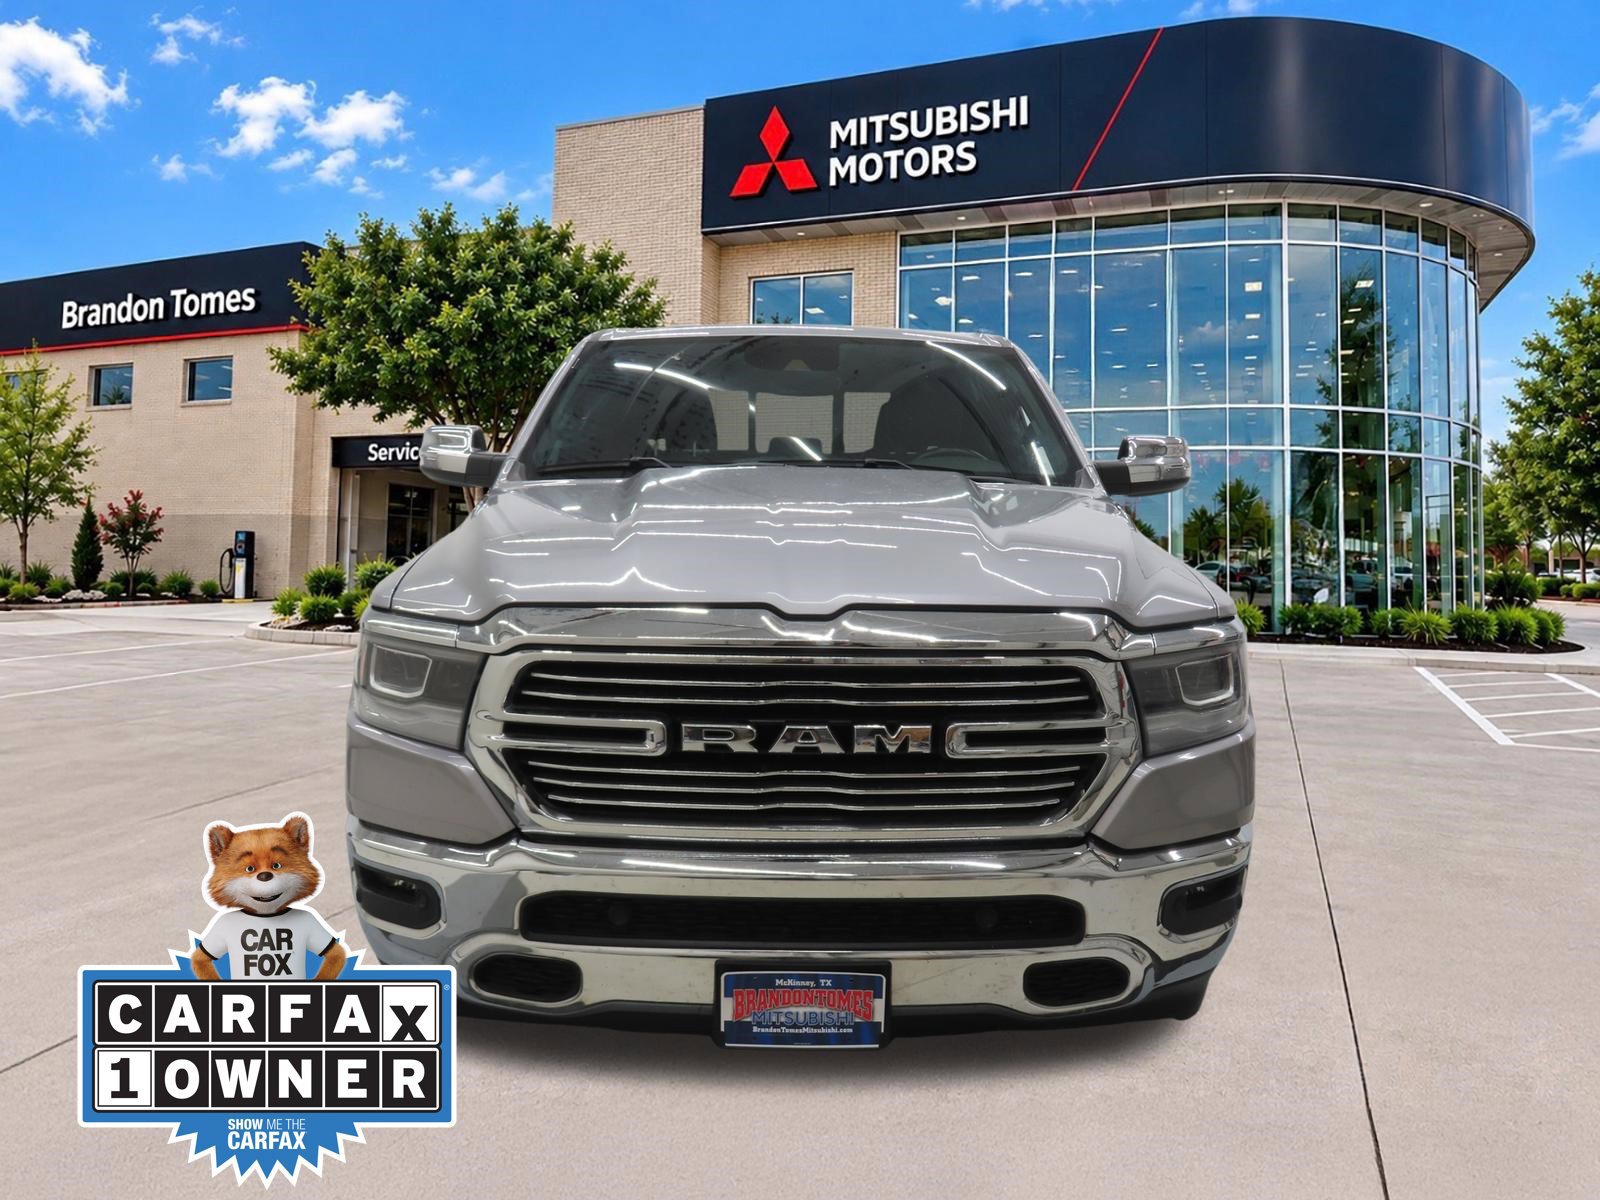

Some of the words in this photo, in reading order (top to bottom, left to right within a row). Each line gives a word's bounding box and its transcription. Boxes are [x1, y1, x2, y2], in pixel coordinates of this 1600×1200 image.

[829, 95, 1029, 149] MITSUBISHI
[828, 141, 977, 187] MOTORS
[61, 293, 164, 329] Brandon
[170, 288, 256, 318] Tomes
[367, 441, 420, 461] Servic
[681, 723, 933, 754] RAM
[775, 979, 817, 988] McKinney,
[819, 979, 832, 987] TX
[751, 1011, 855, 1026] MITSUBISHI
[752, 1026, 853, 1034] BrandonTomesMitsubishi.com
